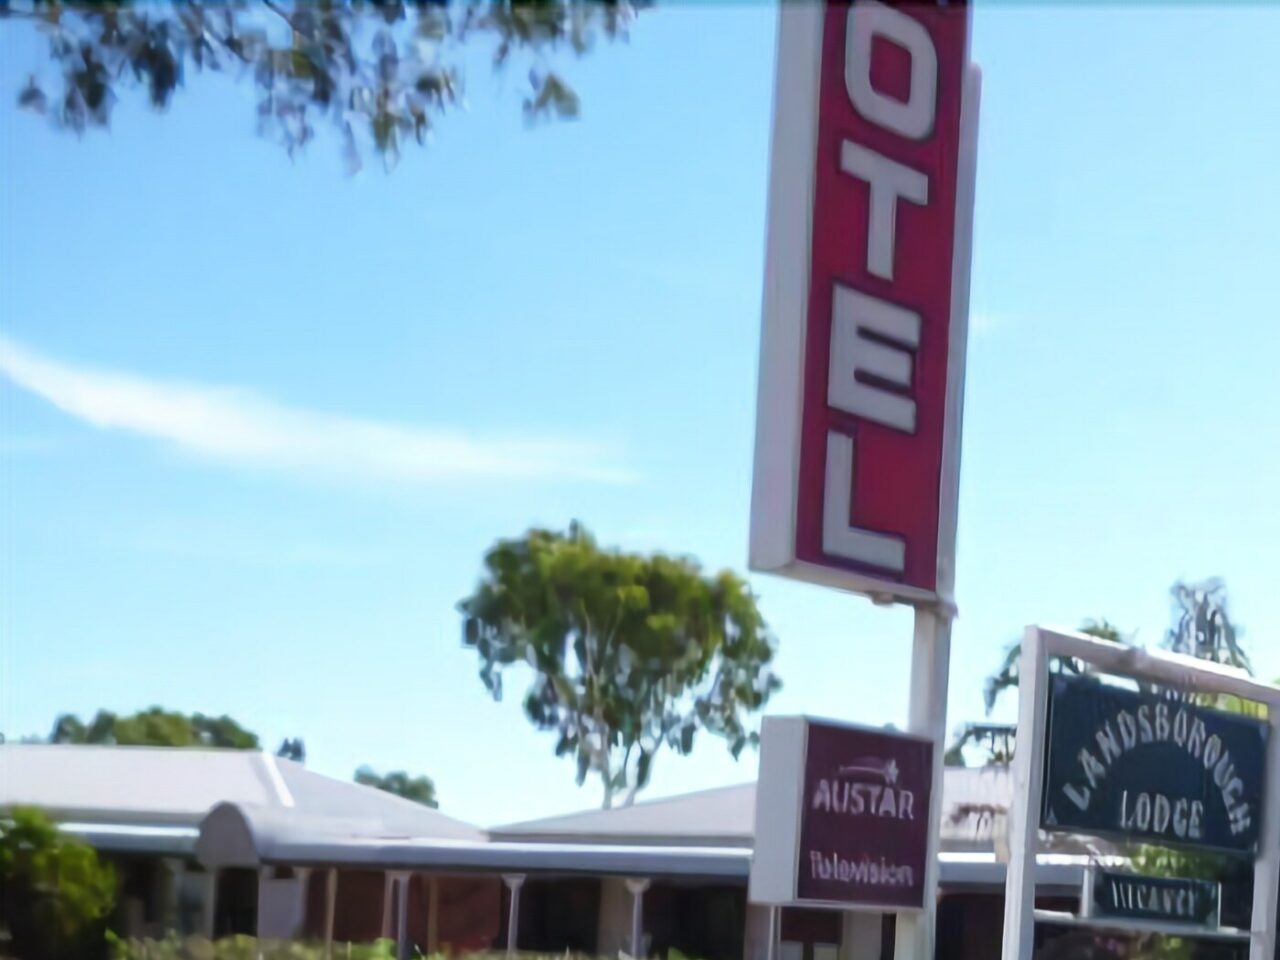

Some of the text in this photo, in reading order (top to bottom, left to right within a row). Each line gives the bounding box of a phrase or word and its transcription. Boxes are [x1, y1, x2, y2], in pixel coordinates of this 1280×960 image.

[822, 0, 938, 571] OTEL
[1062, 702, 1250, 835] LANDSBOROUGH
[813, 778, 914, 820] AUSTAR
[1120, 790, 1204, 838] LODGE
[810, 850, 913, 887] Television
